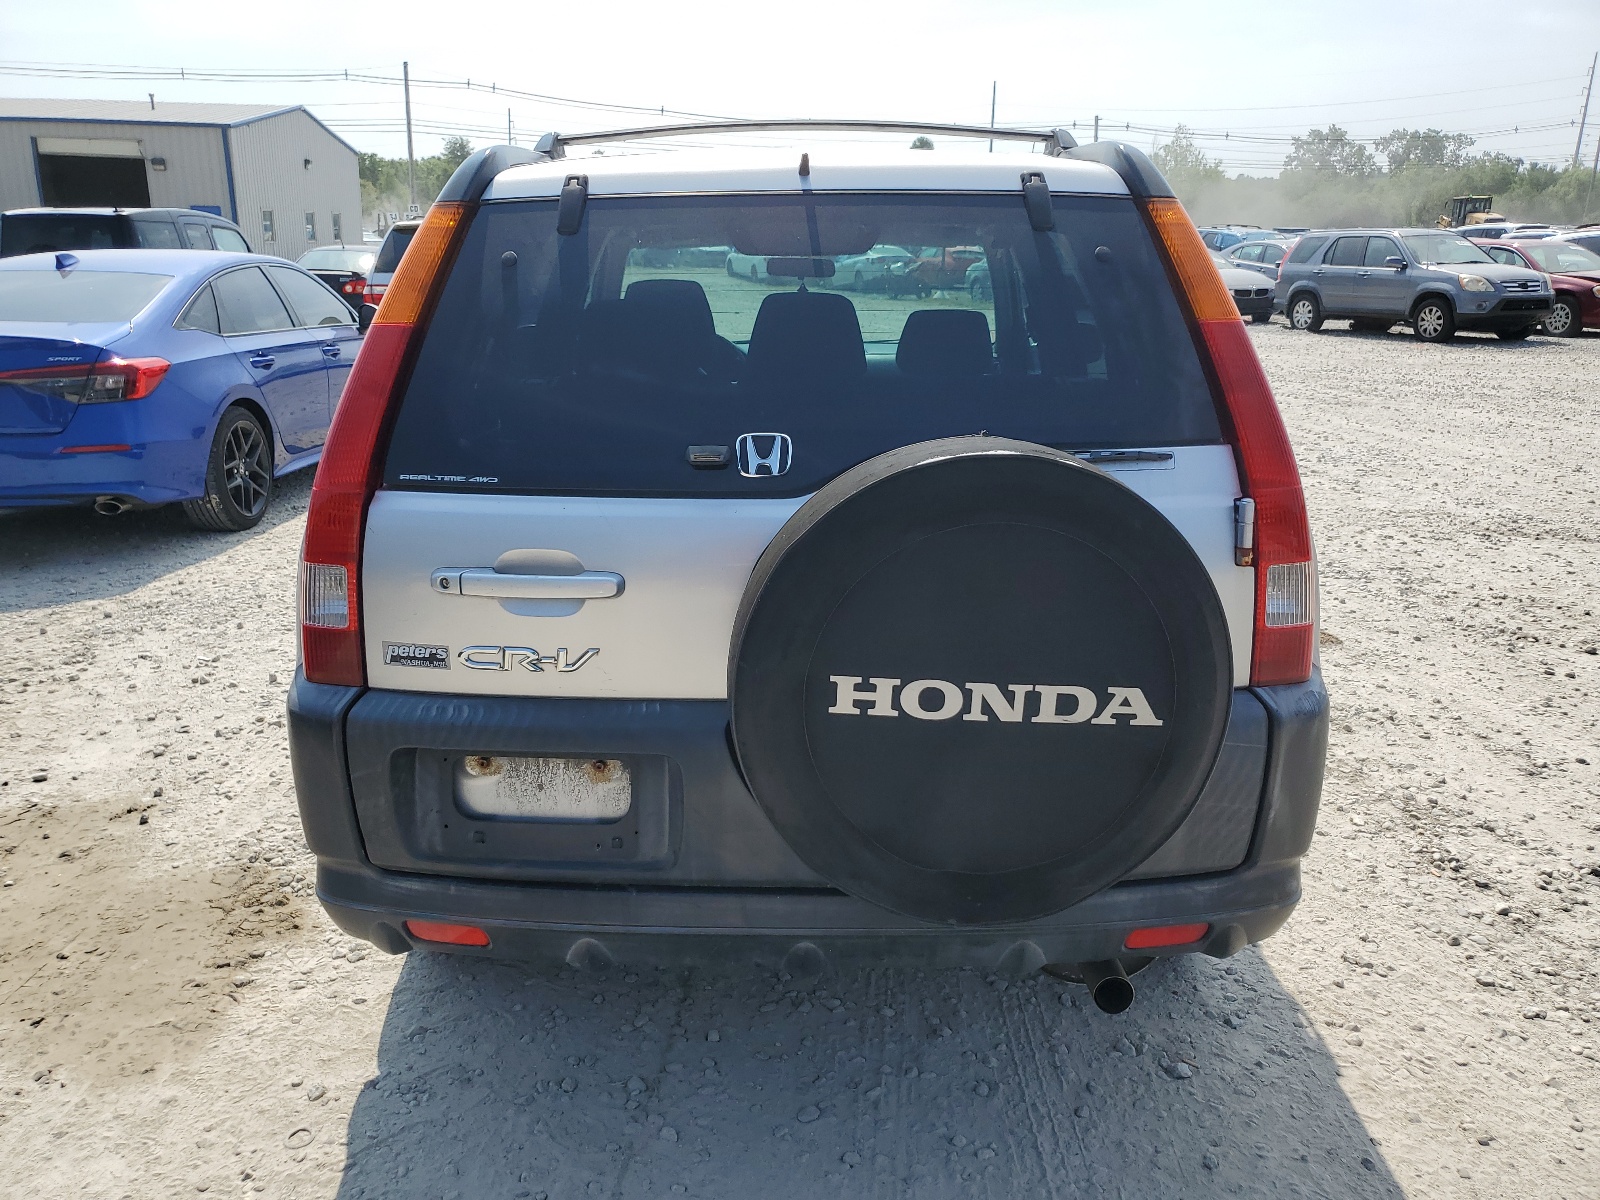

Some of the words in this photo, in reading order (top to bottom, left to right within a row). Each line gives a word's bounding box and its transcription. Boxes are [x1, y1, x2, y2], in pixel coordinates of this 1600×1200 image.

[385, 644, 448, 664] peters
[458, 645, 600, 673] CR-V
[828, 675, 1164, 726] HONDA
